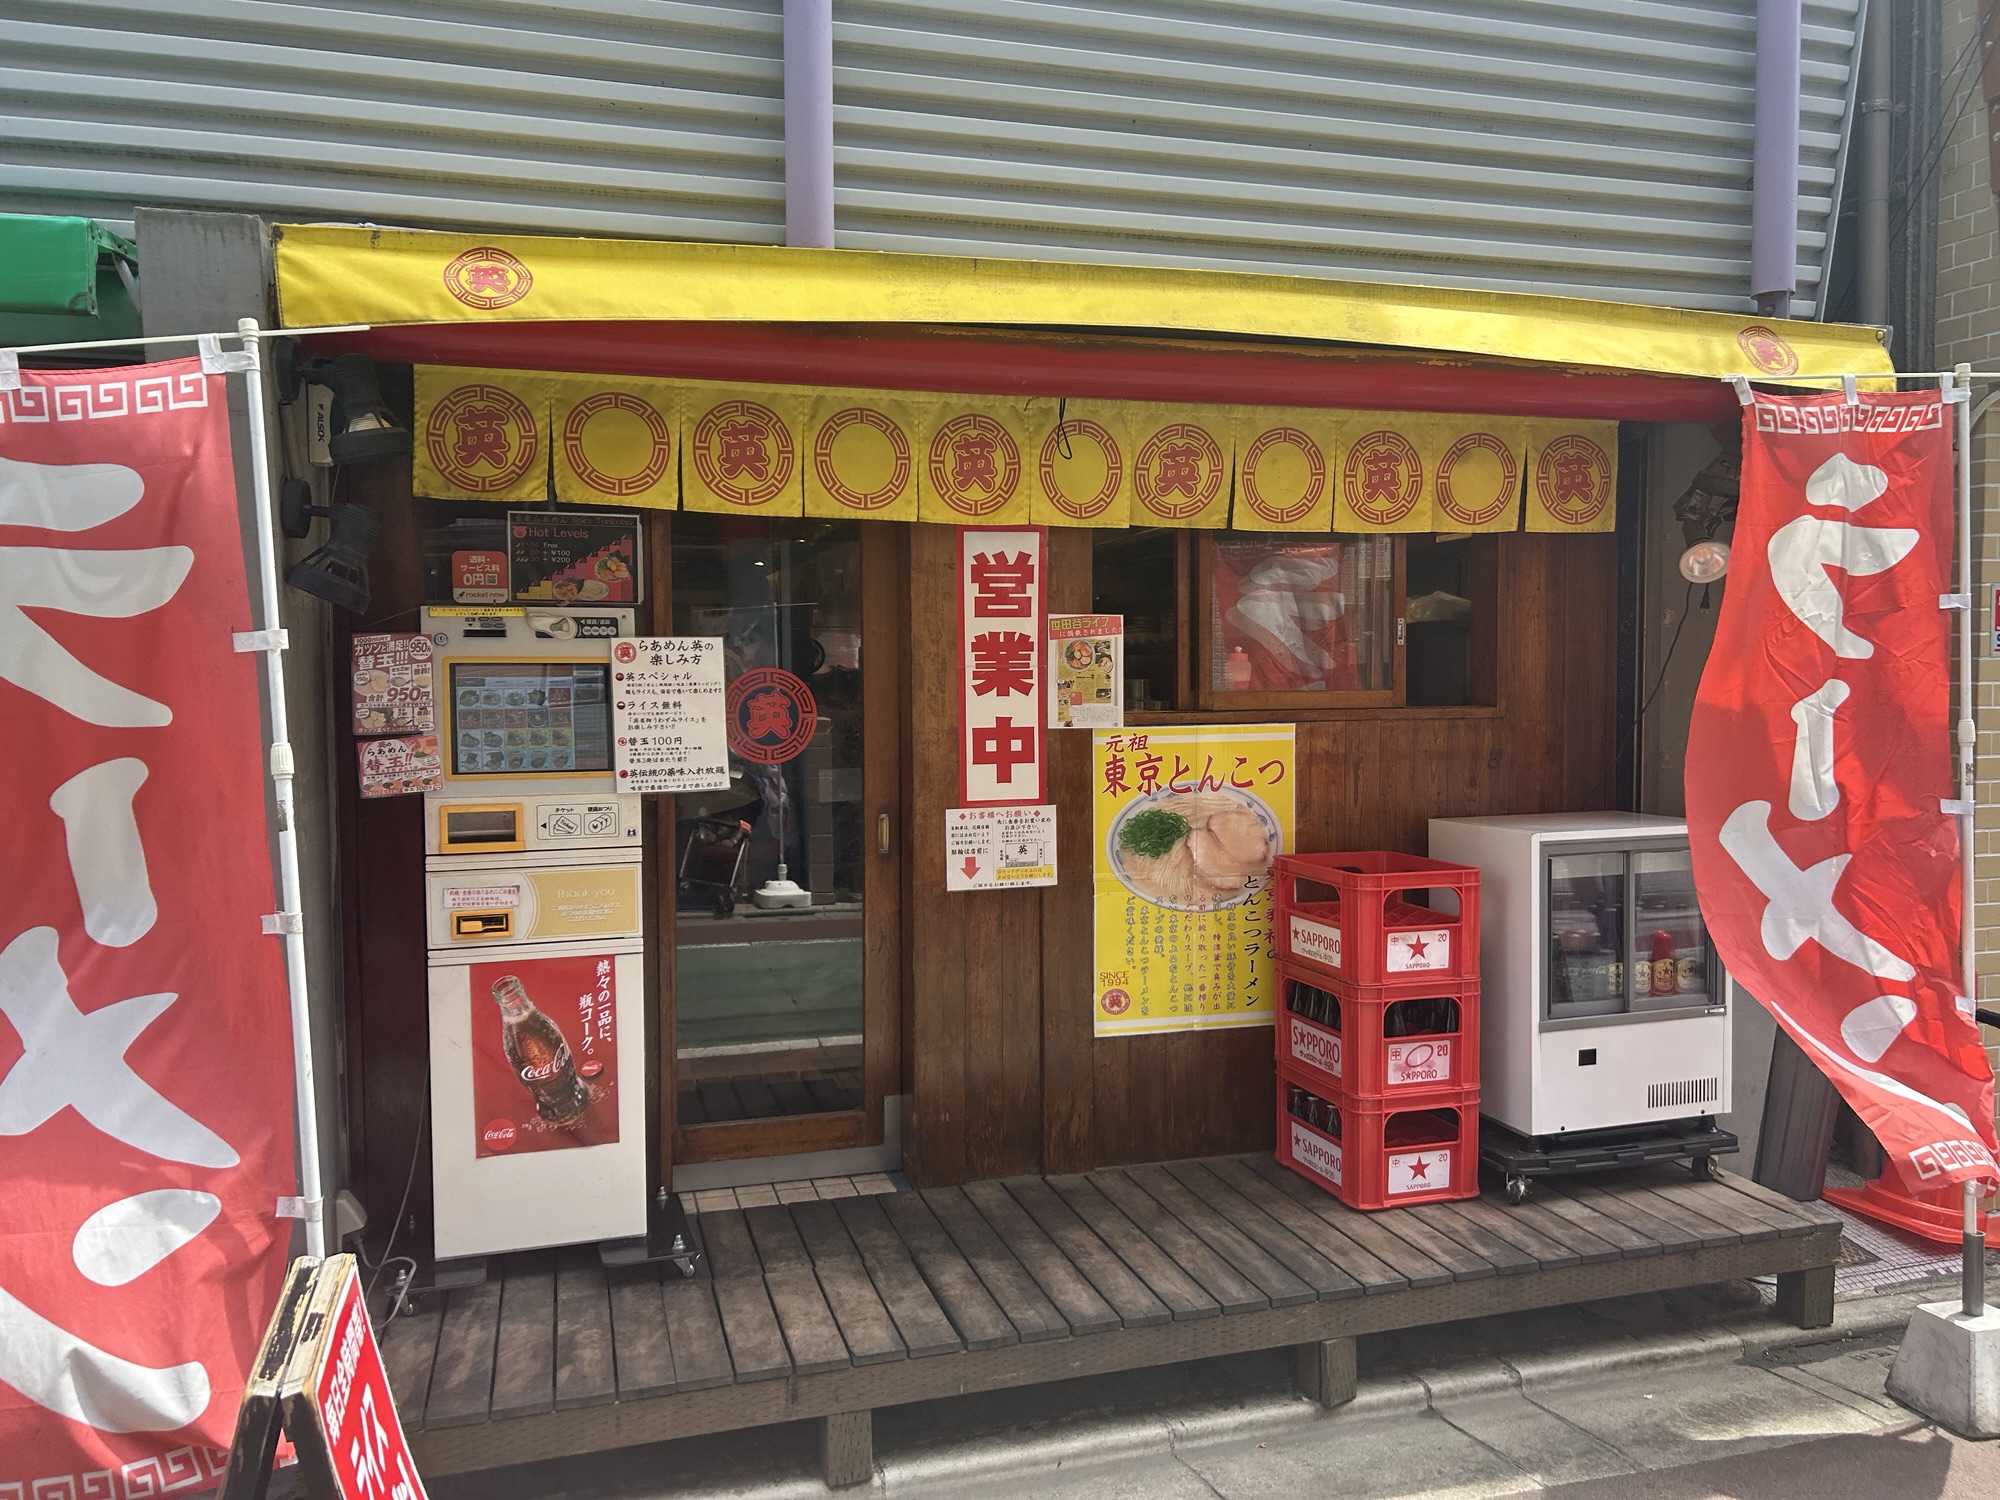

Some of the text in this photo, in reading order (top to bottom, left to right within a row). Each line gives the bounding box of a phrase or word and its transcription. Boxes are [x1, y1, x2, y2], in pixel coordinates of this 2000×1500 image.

[468, 266, 509, 294] 英
[316, 412, 325, 442] ALSOK
[453, 407, 510, 470] 英
[717, 420, 771, 483] 英
[951, 435, 998, 492] 英
[1157, 443, 1200, 499] 英
[1362, 449, 1402, 504] 英
[1553, 450, 1593, 505] 英
[528, 528, 589, 539] Hot Levels
[542, 541, 559, 549] Free
[551, 549, 571, 557] ¥100
[460, 563, 500, 573] サービス料
[463, 573, 486, 586] 0円
[465, 591, 489, 599] rocket
[1050, 616, 1110, 631] 世田谷ライフ
[354, 639, 410, 656] ガツンと満足!!
[409, 642, 432, 653] 950円
[638, 639, 714, 652] らあめん英の
[649, 653, 703, 666] 楽しみ方
[970, 550, 1036, 784] 営業中
[625, 672, 692, 682] 英スペシャル
[368, 687, 430, 702] 合計 950円
[627, 701, 682, 710] ライス無料
[746, 689, 794, 740] 英
[629, 736, 682, 746] 替玉100円
[1105, 733, 1149, 753] 元祖
[367, 746, 407, 756] らあめん
[629, 766, 726, 779] 英伝統の薬味入れ放題
[1102, 752, 1286, 799] 東京とんこつ
[969, 809, 1032, 820] お客様へお願い
[1017, 844, 1028, 855] 英
[557, 887, 616, 899] Thank you
[1242, 875, 1262, 1007] とんこつラーメン
[1300, 929, 1341, 955] SAPPORO
[1437, 933, 1447, 942] 20
[1100, 970, 1129, 979] SINCE
[1101, 978, 1129, 987] 1994
[596, 959, 613, 1043] 熱々の一品に、
[578, 993, 595, 1055] 瓶コーク。
[1437, 1044, 1448, 1057] 20
[484, 1127, 515, 1141] Coca-Cola
[1302, 1138, 1341, 1170] SAPPORO
[1438, 1153, 1448, 1162] 20
[1406, 1182, 1431, 1190] SAPPORO
